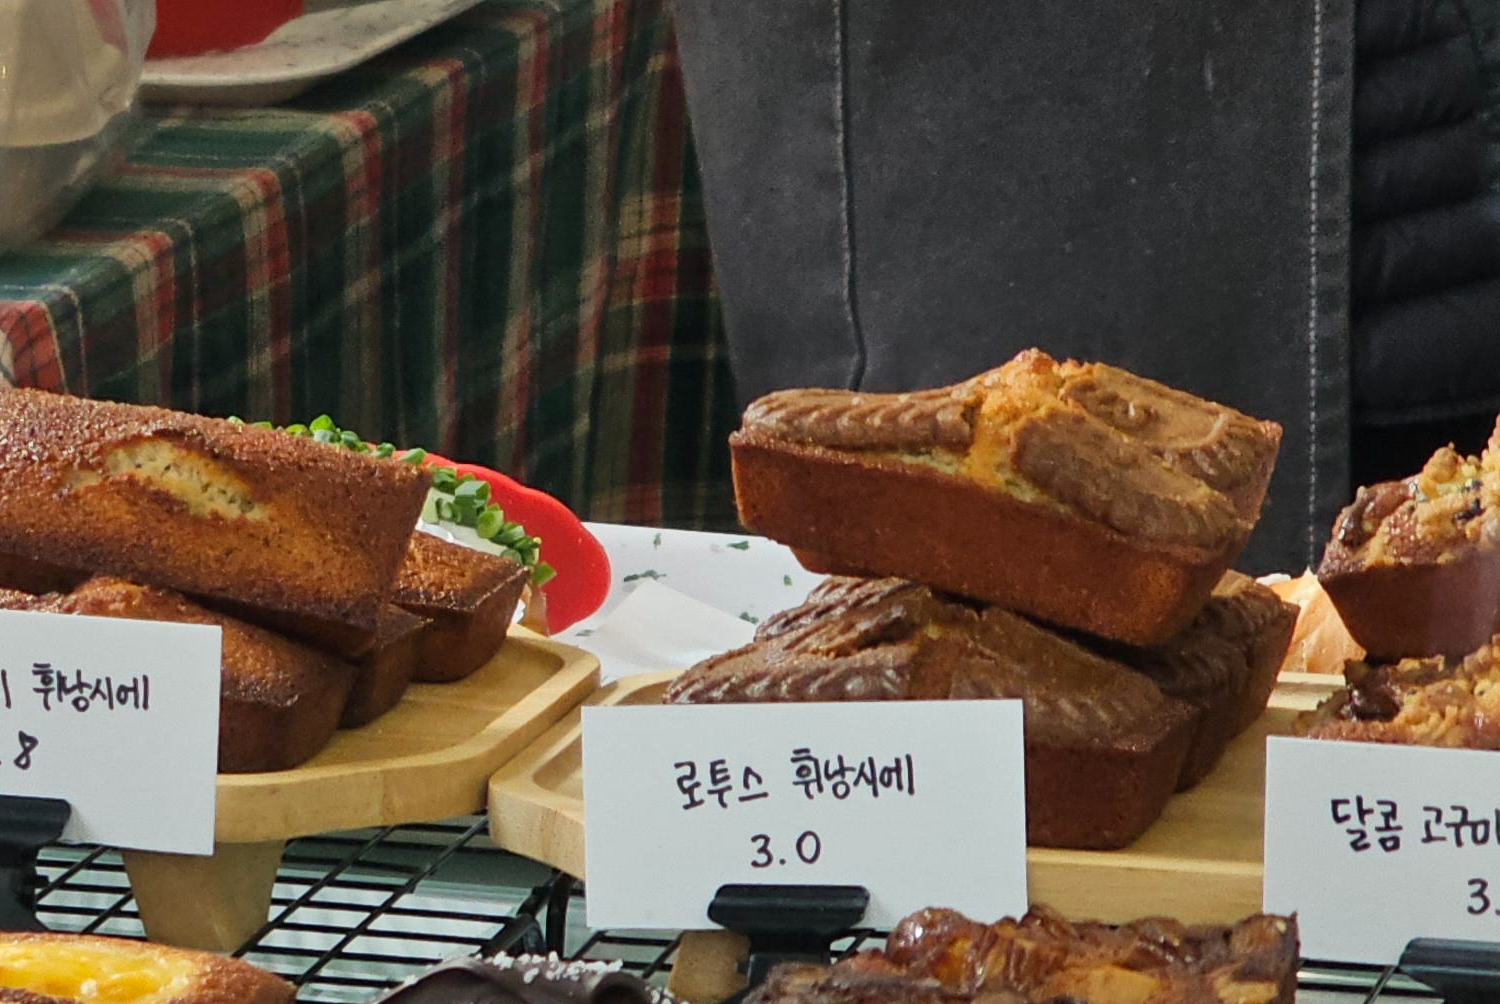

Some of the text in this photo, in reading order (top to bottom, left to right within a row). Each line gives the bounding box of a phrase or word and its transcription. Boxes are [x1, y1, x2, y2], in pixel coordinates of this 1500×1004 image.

[31, 662, 150, 713] 휘낭시에
[673, 747, 916, 811] 로투스 휘낭시에
[750, 829, 822, 869] 3.0
[1330, 794, 1404, 853] 달콤
